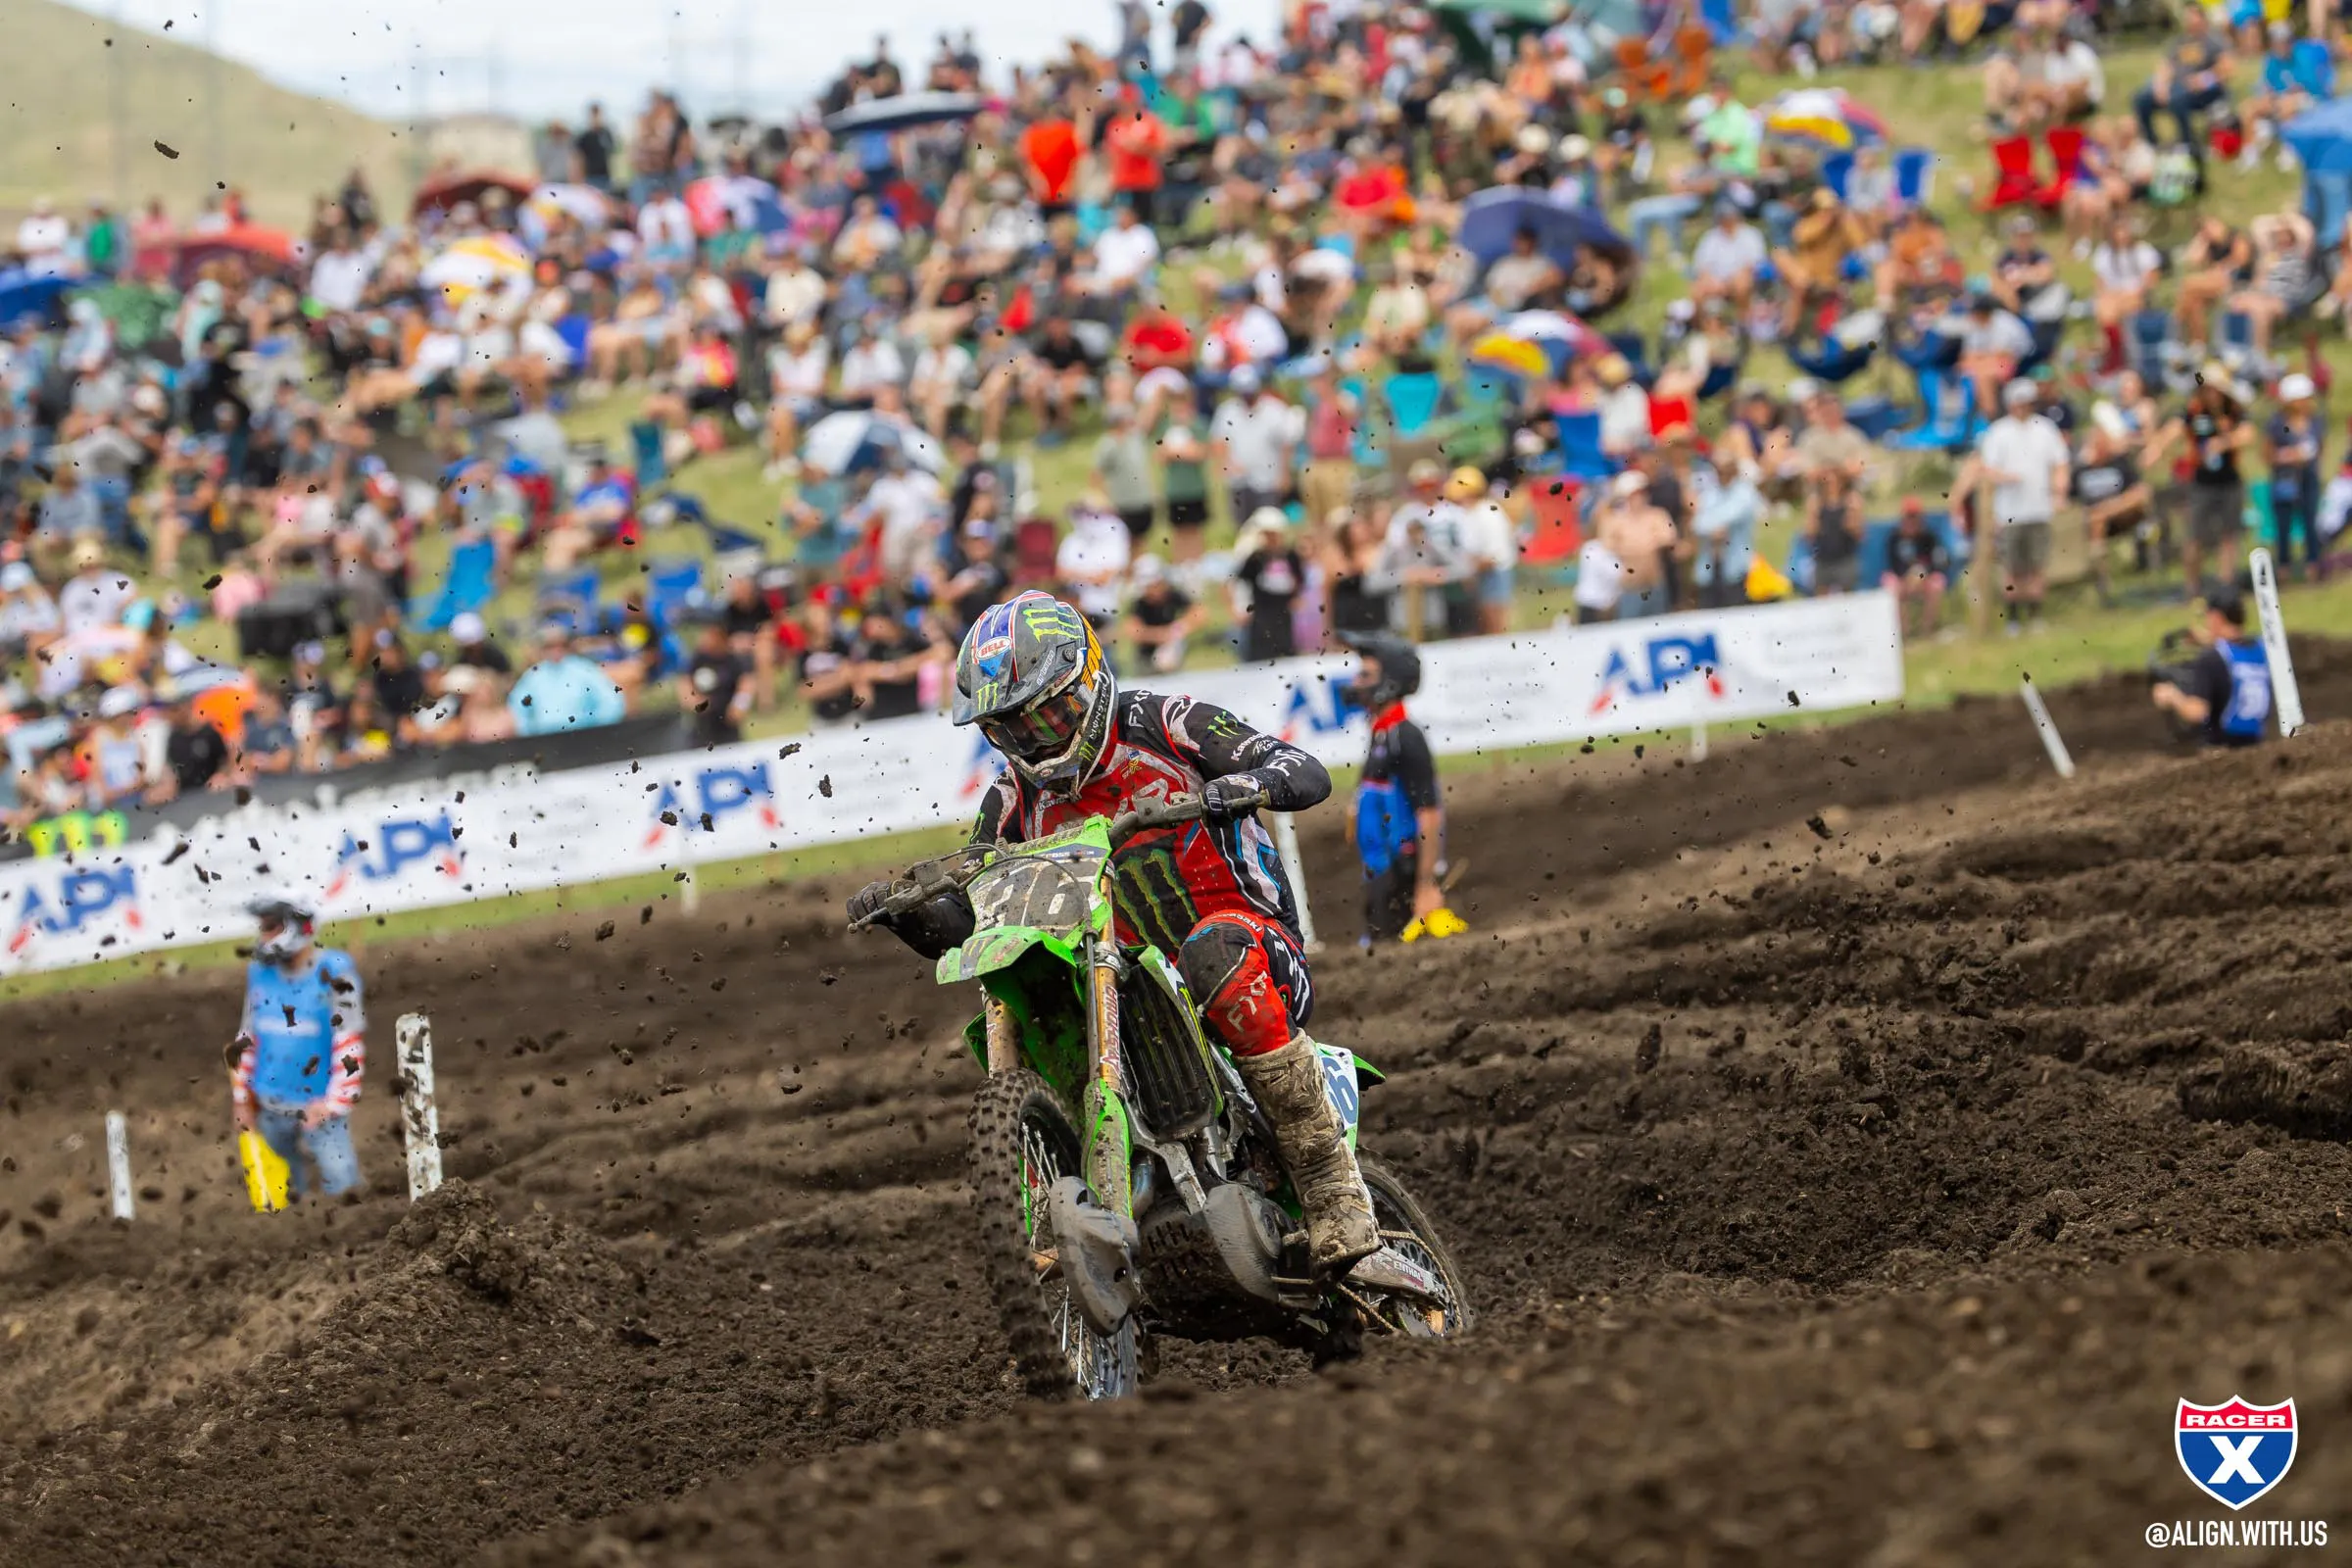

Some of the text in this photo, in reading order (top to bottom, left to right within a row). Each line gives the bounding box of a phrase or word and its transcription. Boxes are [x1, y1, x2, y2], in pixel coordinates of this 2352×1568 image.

[980, 640, 1006, 657] BELL
[1276, 677, 1369, 743] AP
[1393, 1260, 1423, 1282] ENTHAL
